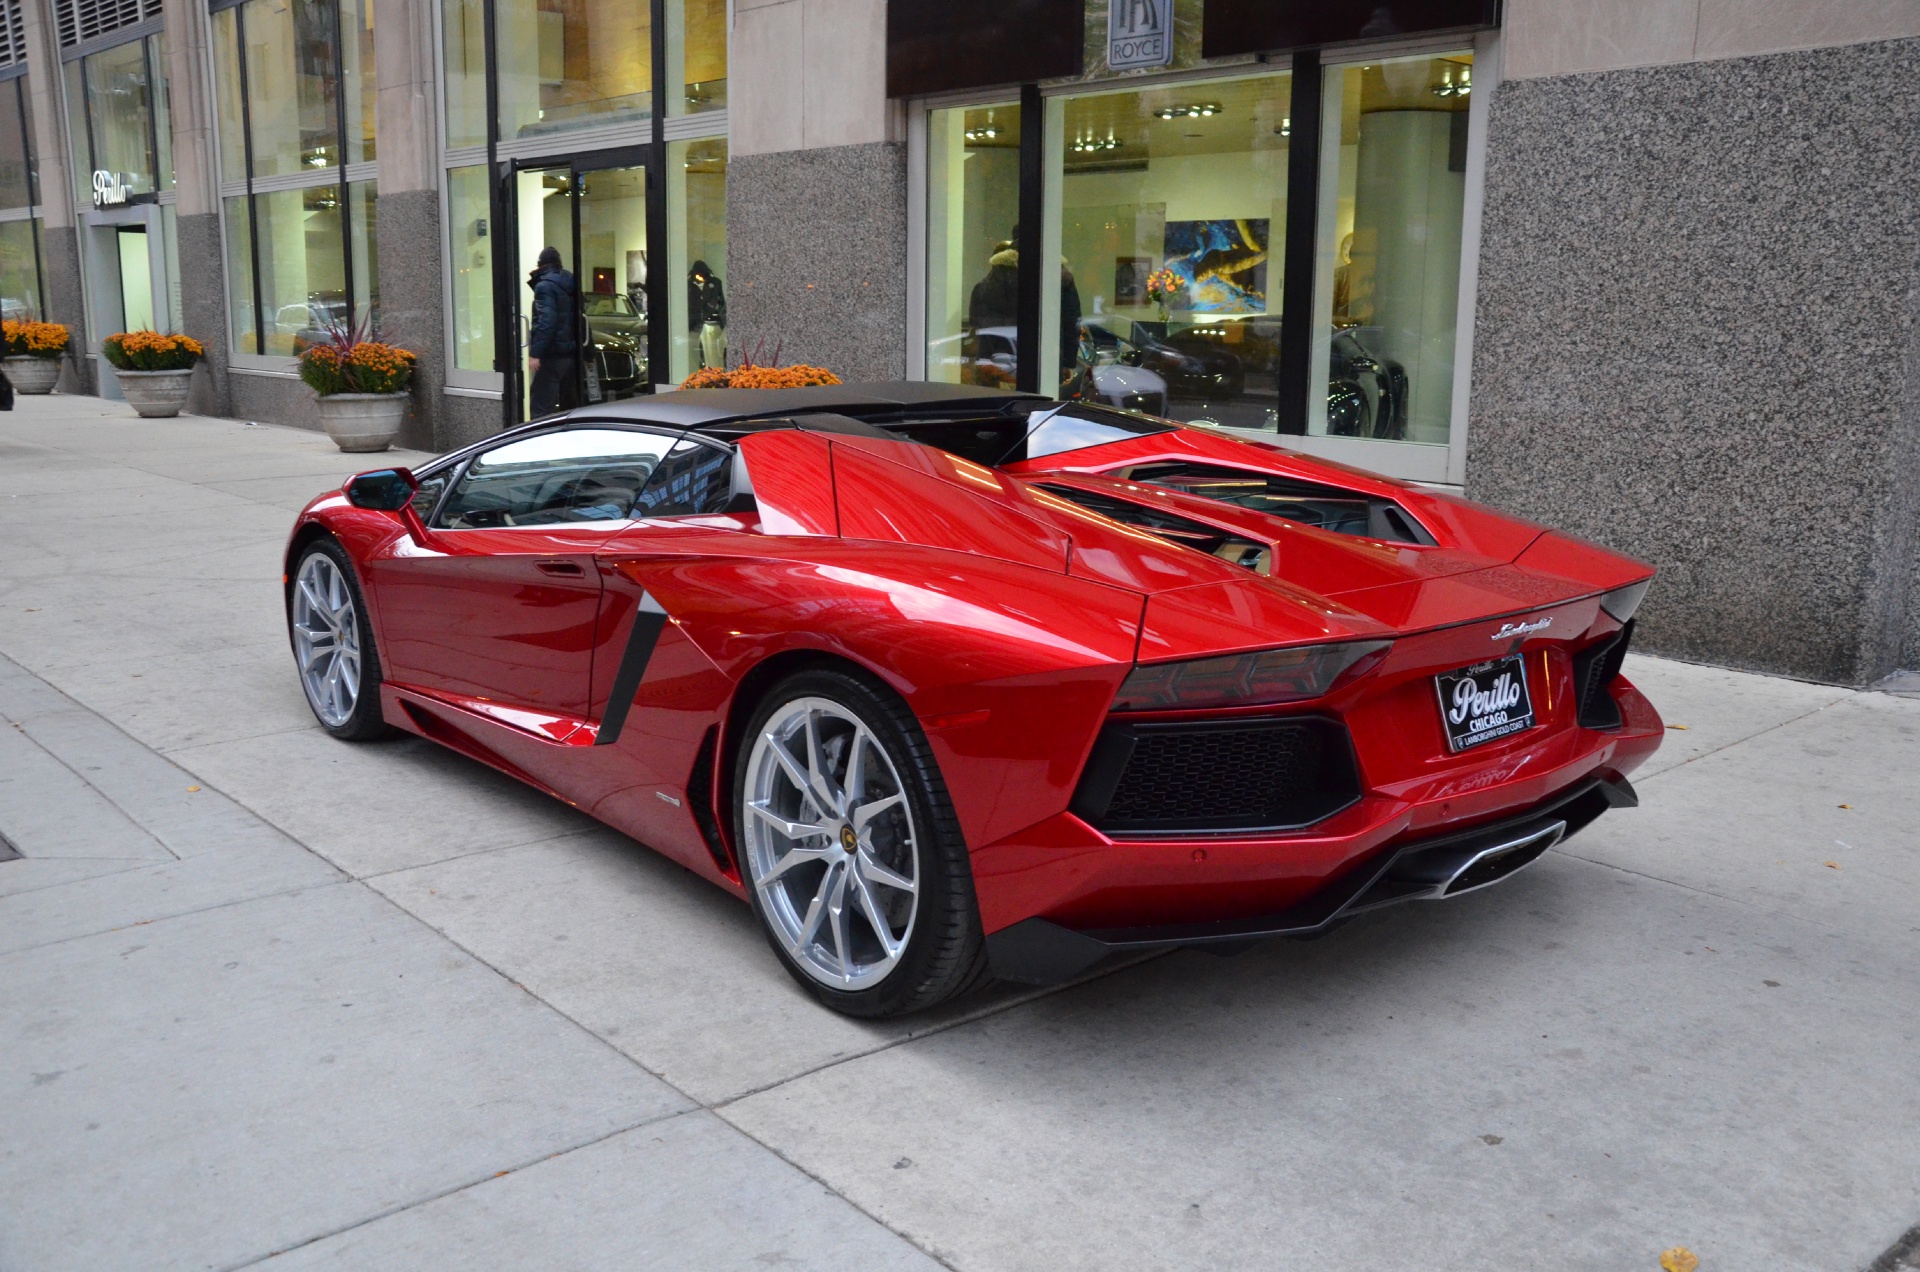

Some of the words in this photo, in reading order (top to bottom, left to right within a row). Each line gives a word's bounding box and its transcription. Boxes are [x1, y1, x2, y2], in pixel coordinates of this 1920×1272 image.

[1114, 38, 1160, 59] ROYCE
[93, 170, 127, 206] Perillo
[1449, 673, 1520, 725] Perillo
[1464, 729, 1497, 746] LAMBORGHINI
[1497, 724, 1510, 736] GOLD
[1510, 720, 1525, 732] COAST
[1470, 711, 1508, 732] CHICAGO
